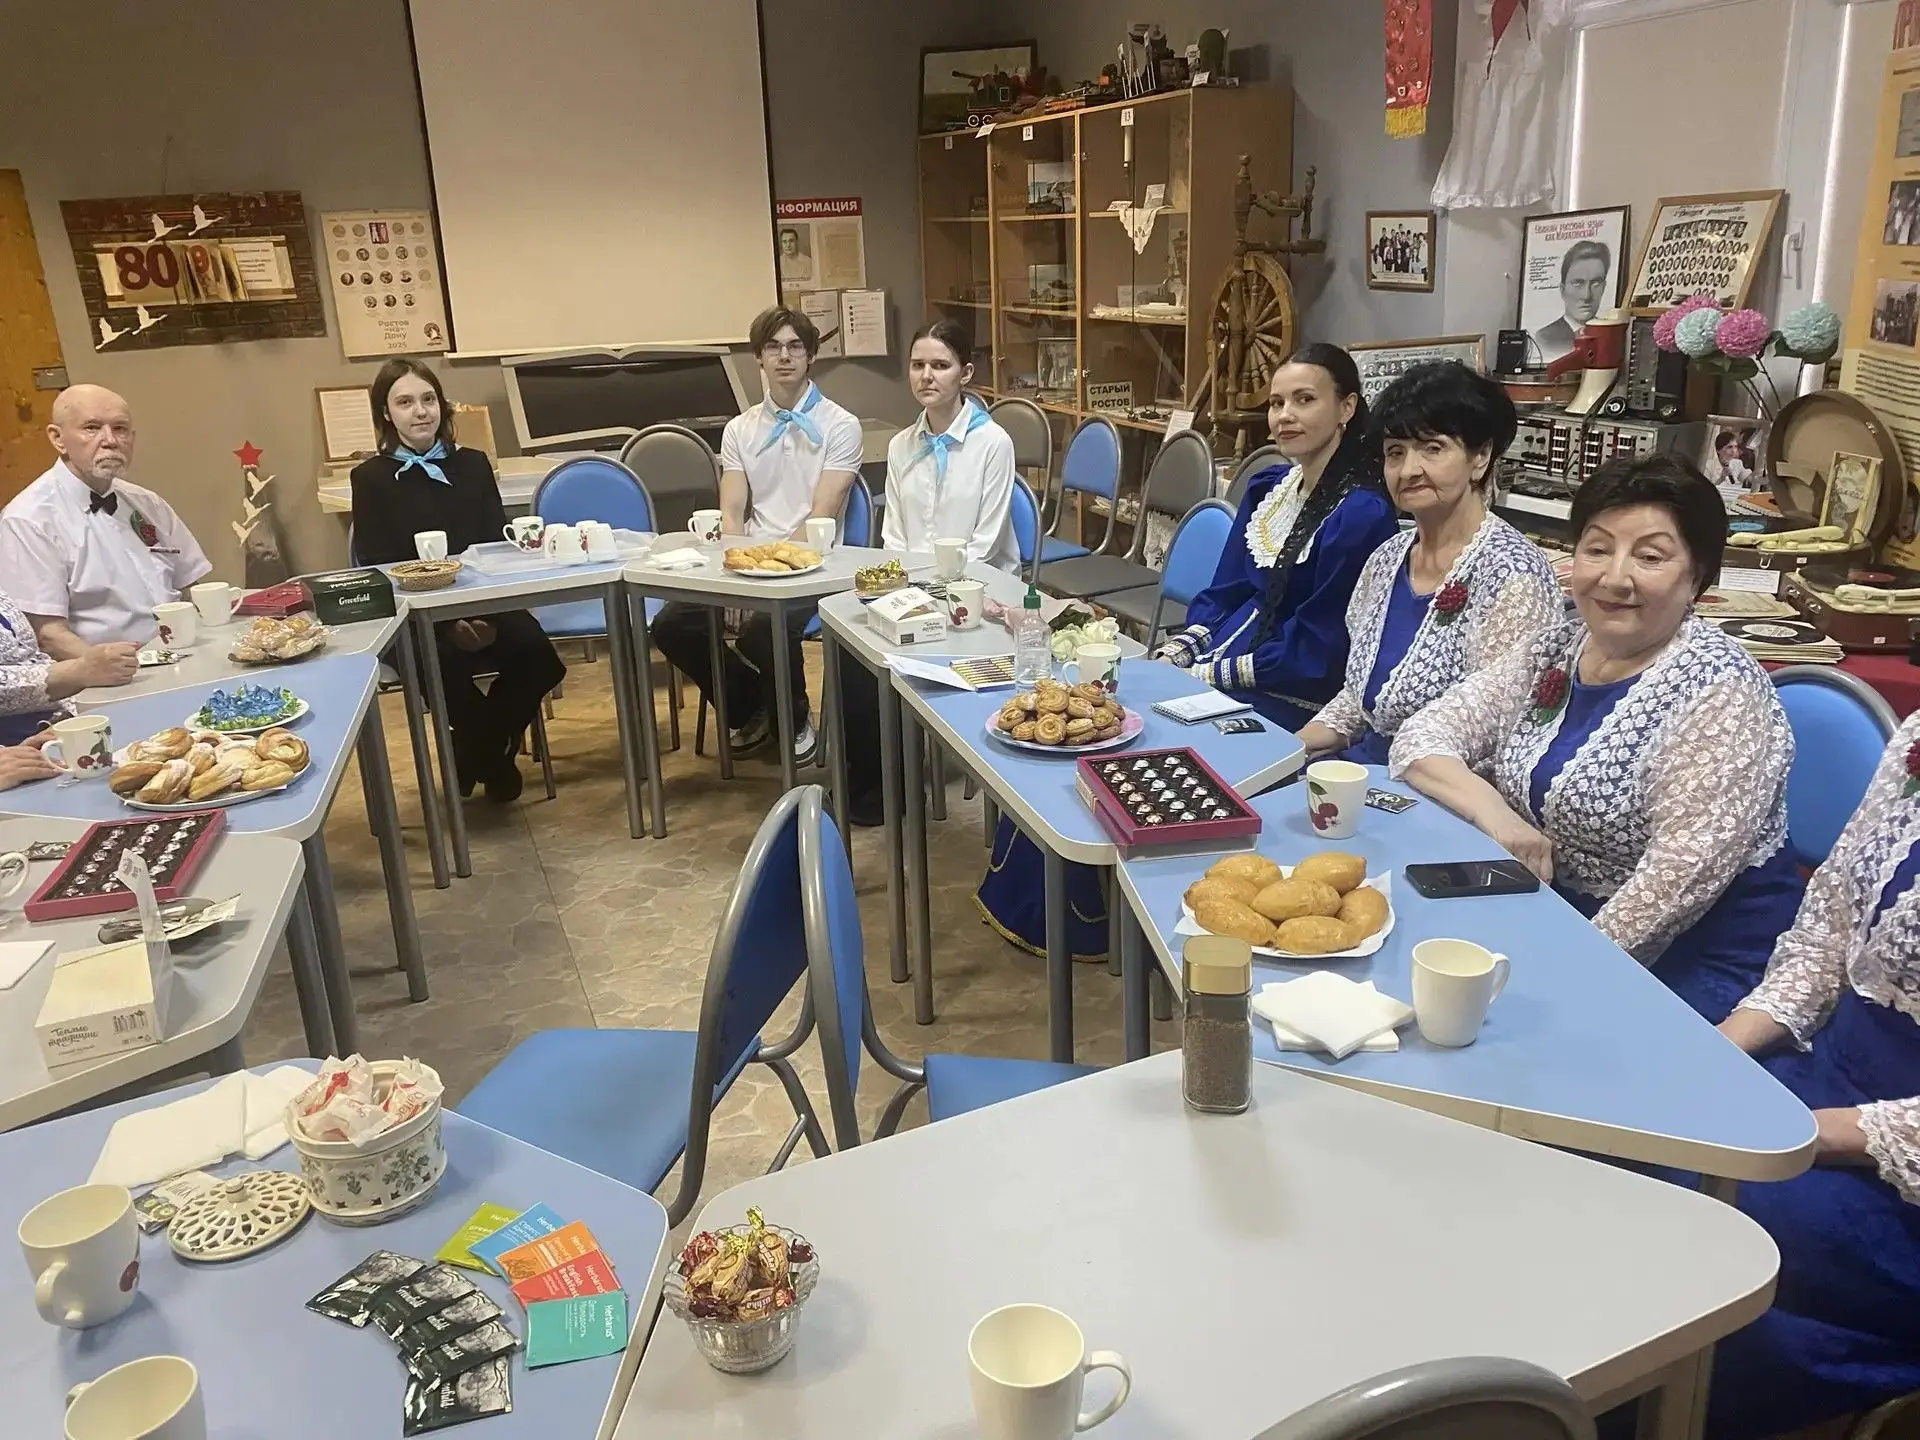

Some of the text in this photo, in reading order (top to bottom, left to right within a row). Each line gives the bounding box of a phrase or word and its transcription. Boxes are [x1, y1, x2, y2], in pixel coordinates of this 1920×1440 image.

[776, 201, 858, 214] НФОРМАЦИЯ
[114, 244, 180, 290] 80
[1089, 384, 1131, 395] СТАРЫЙ
[1091, 398, 1131, 409] РОСТОВ
[338, 593, 371, 606] Greenfield
[567, 1263, 584, 1287] English
[604, 1304, 616, 1340] Herbarus
